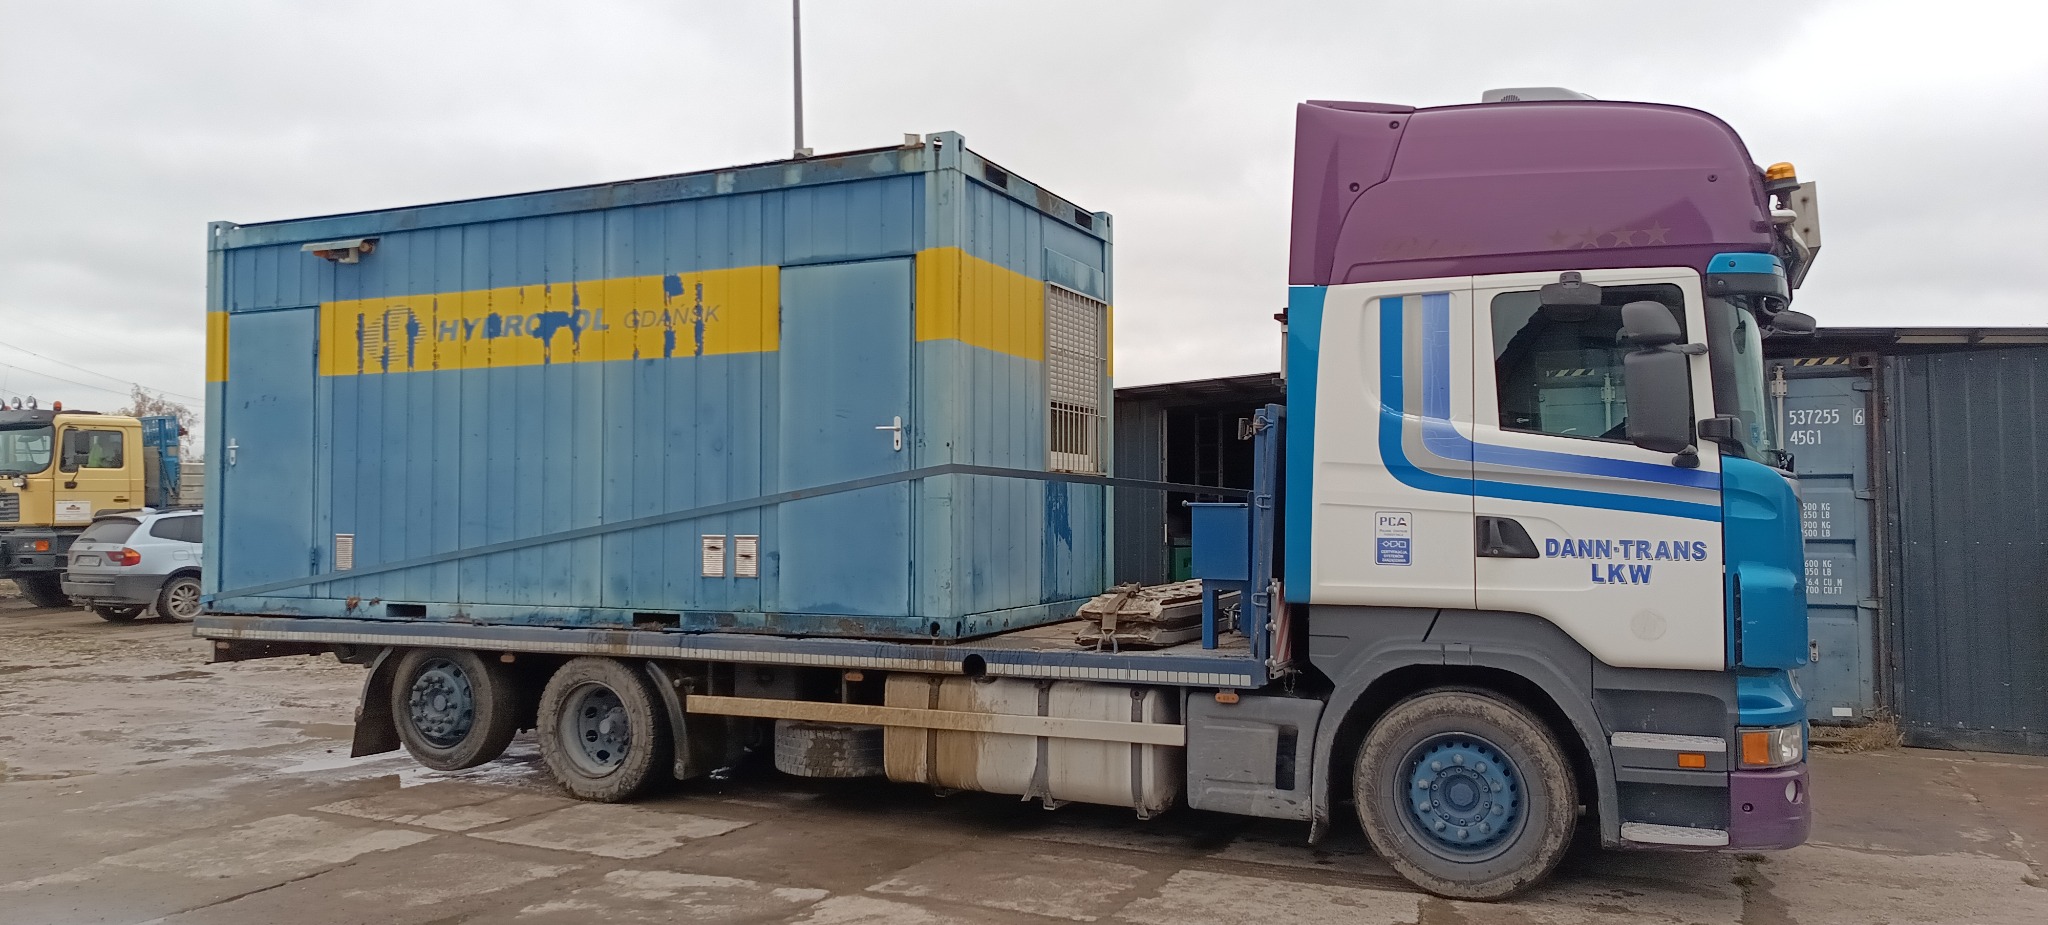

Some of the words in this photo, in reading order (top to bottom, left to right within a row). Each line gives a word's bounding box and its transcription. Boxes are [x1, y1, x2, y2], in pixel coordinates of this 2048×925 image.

[1789, 409, 1839, 425] 537255
[1855, 409, 1863, 424] 6
[1790, 429, 1822, 445] 45G1
[1821, 502, 1831, 511] KG
[1803, 511, 1818, 519] 650
[1821, 511, 1830, 519] LB
[1379, 516, 1408, 527] PCA
[1821, 521, 1831, 529] KG
[1821, 529, 1831, 537] LB
[1804, 559, 1819, 567] 600
[1822, 559, 1832, 567] KG
[1591, 563, 1653, 585] LKW
[1822, 568, 1832, 576] LB
